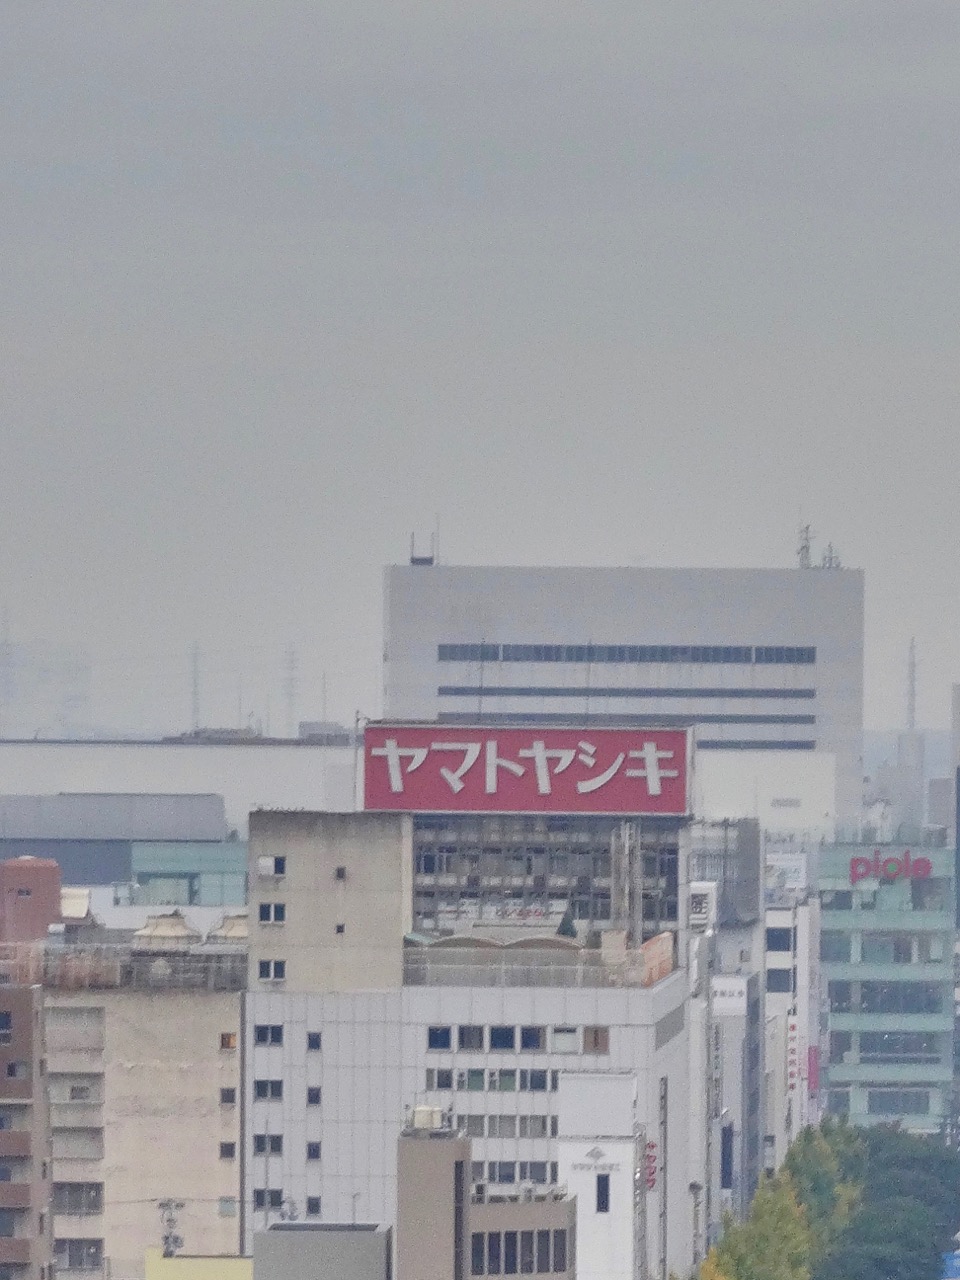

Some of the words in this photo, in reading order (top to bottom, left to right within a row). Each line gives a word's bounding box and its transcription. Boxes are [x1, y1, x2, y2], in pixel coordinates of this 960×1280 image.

[371, 739, 679, 796] ヤマトヤシキ
[849, 849, 932, 885] piole
